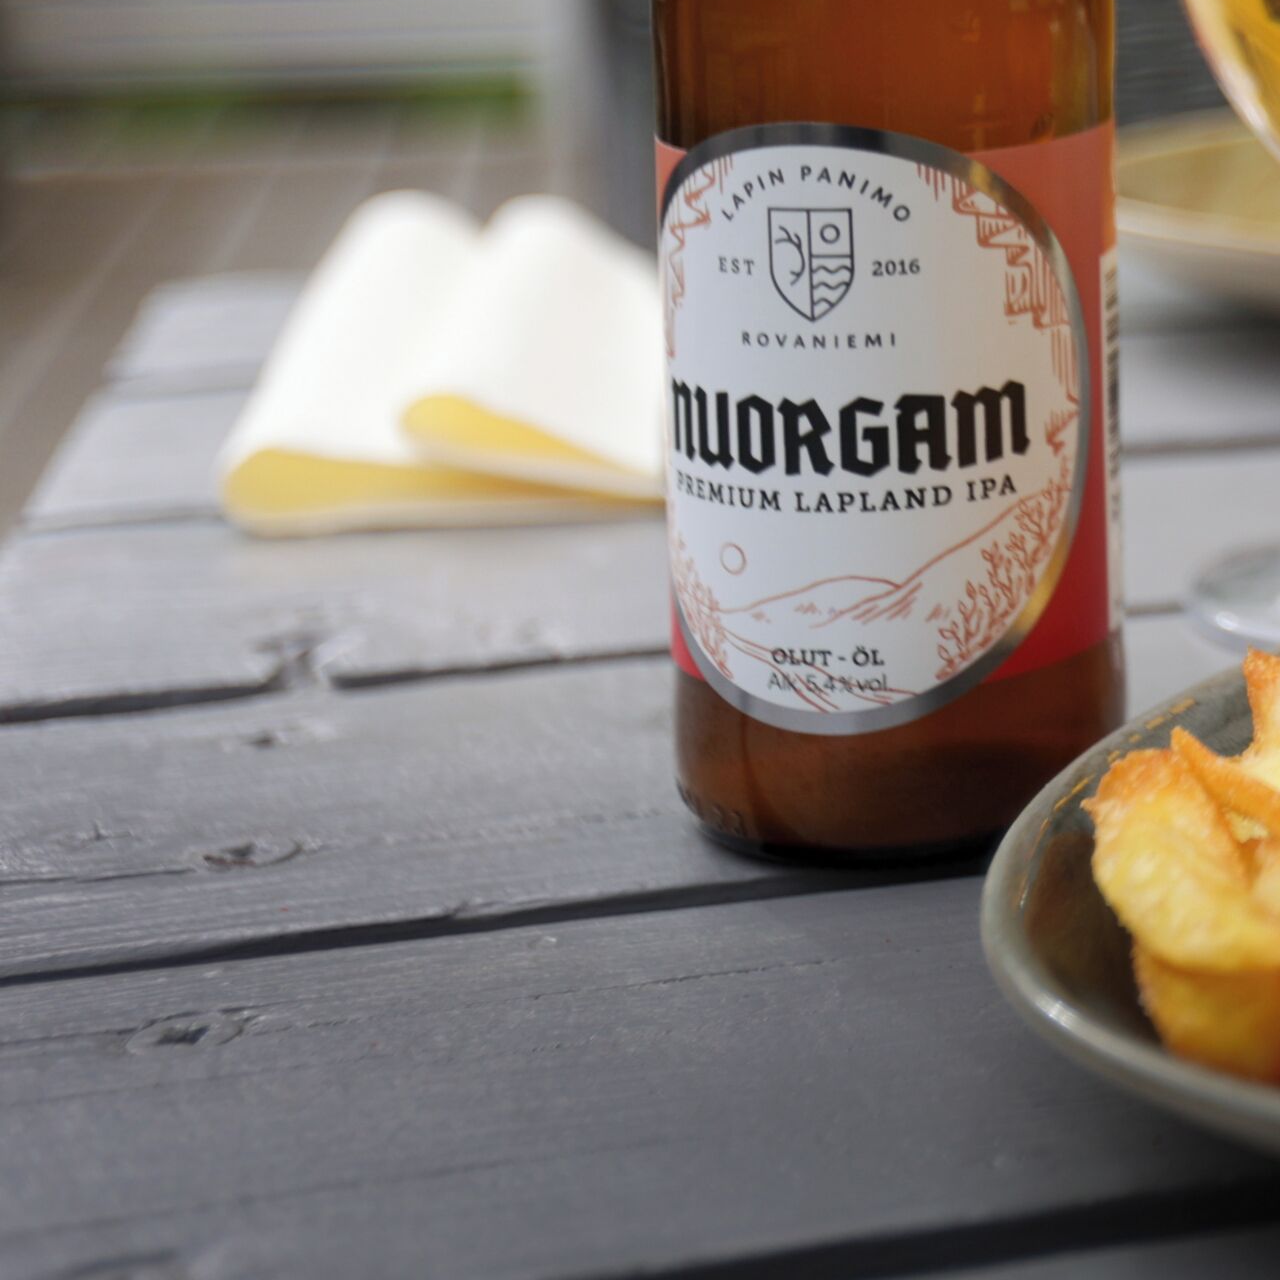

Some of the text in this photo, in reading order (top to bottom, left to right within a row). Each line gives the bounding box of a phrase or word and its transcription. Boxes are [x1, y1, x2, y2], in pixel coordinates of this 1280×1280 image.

[721, 165, 911, 222] LAPIN PANIMO
[718, 256, 755, 275] EST
[872, 258, 920, 277] 2016
[741, 331, 896, 349] ROVANIEMI
[672, 377, 1030, 477] NUORGAM
[677, 469, 1017, 513] PREMIUM LAPLAND IPA
[771, 648, 832, 667] OLUT
[852, 645, 885, 667] ÖL
